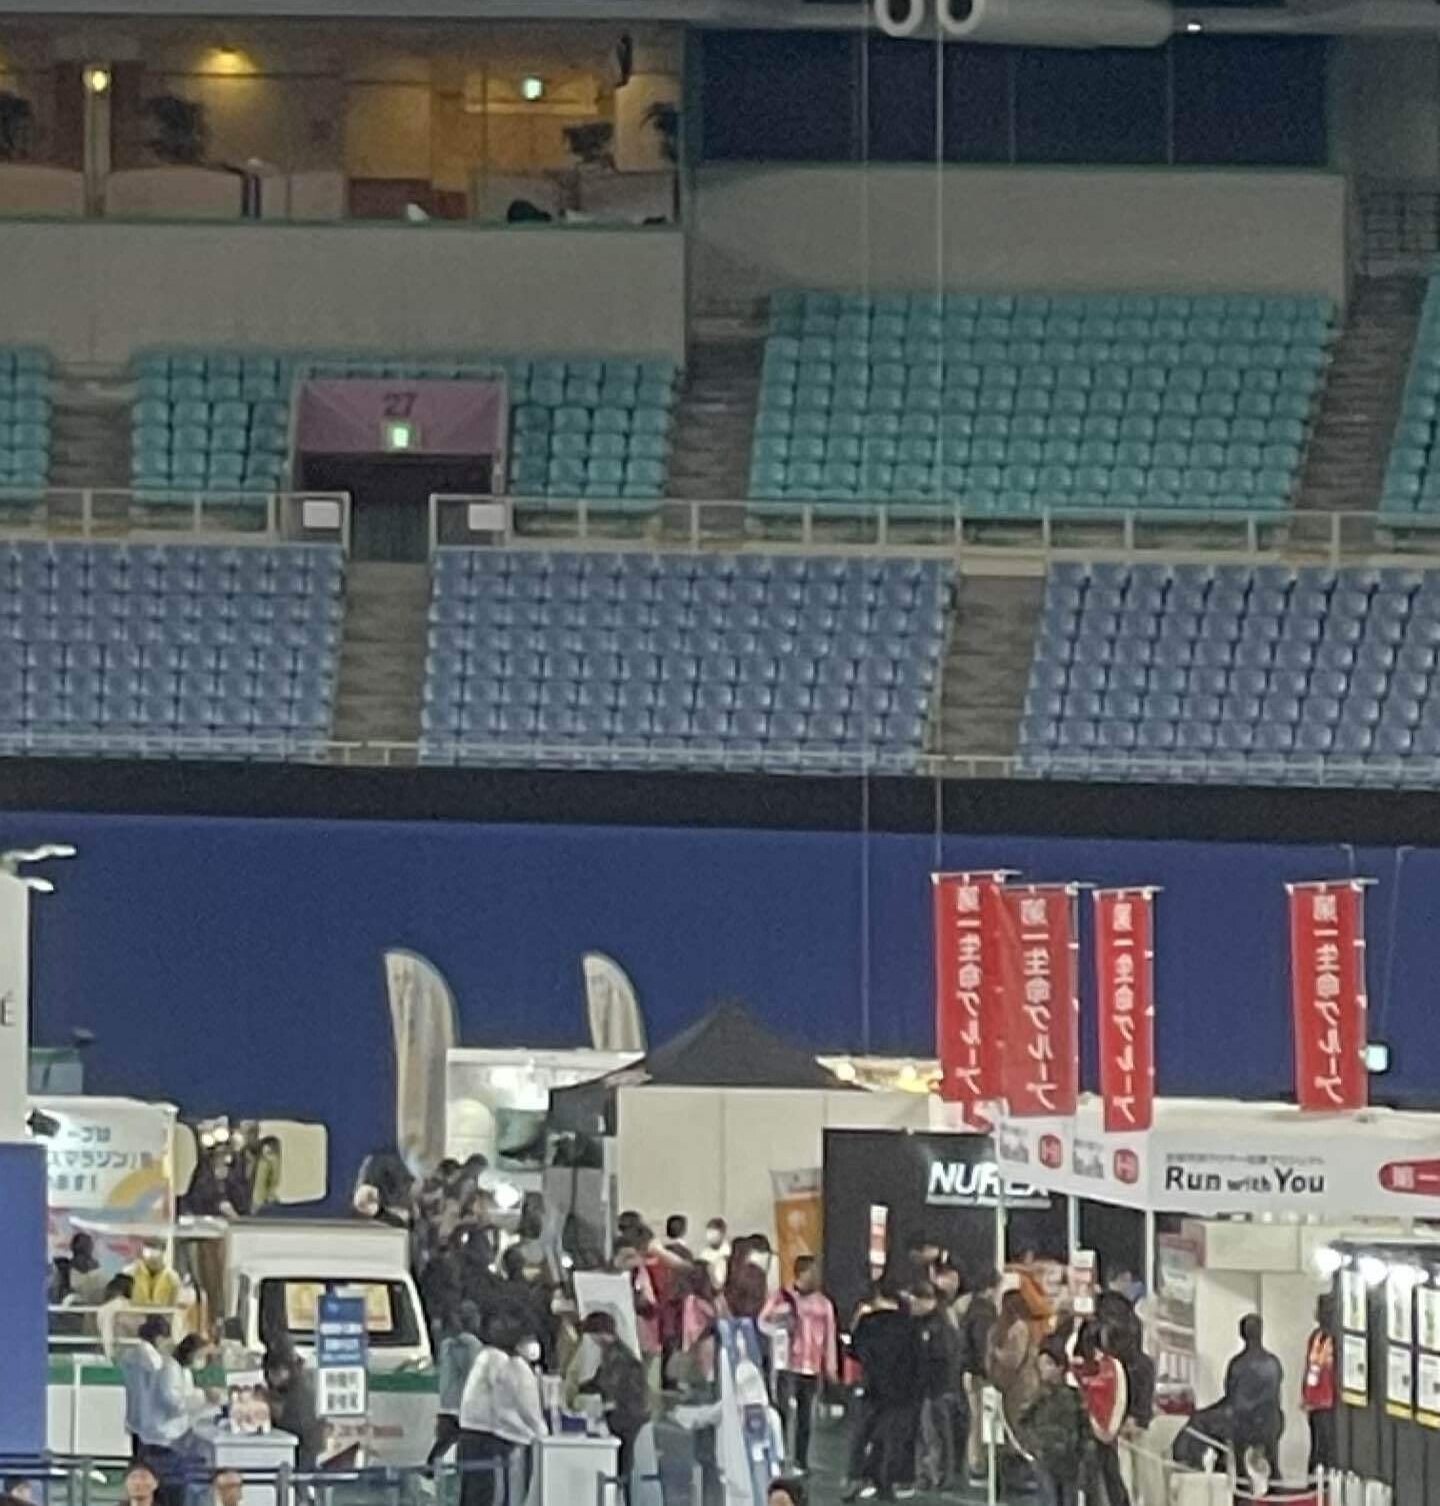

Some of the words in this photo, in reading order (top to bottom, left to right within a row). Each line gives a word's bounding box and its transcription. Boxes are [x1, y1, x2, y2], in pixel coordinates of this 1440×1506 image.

[1165, 1165, 1221, 1191] Run
[1227, 1176, 1272, 1192] with
[1274, 1167, 1325, 1193] You
